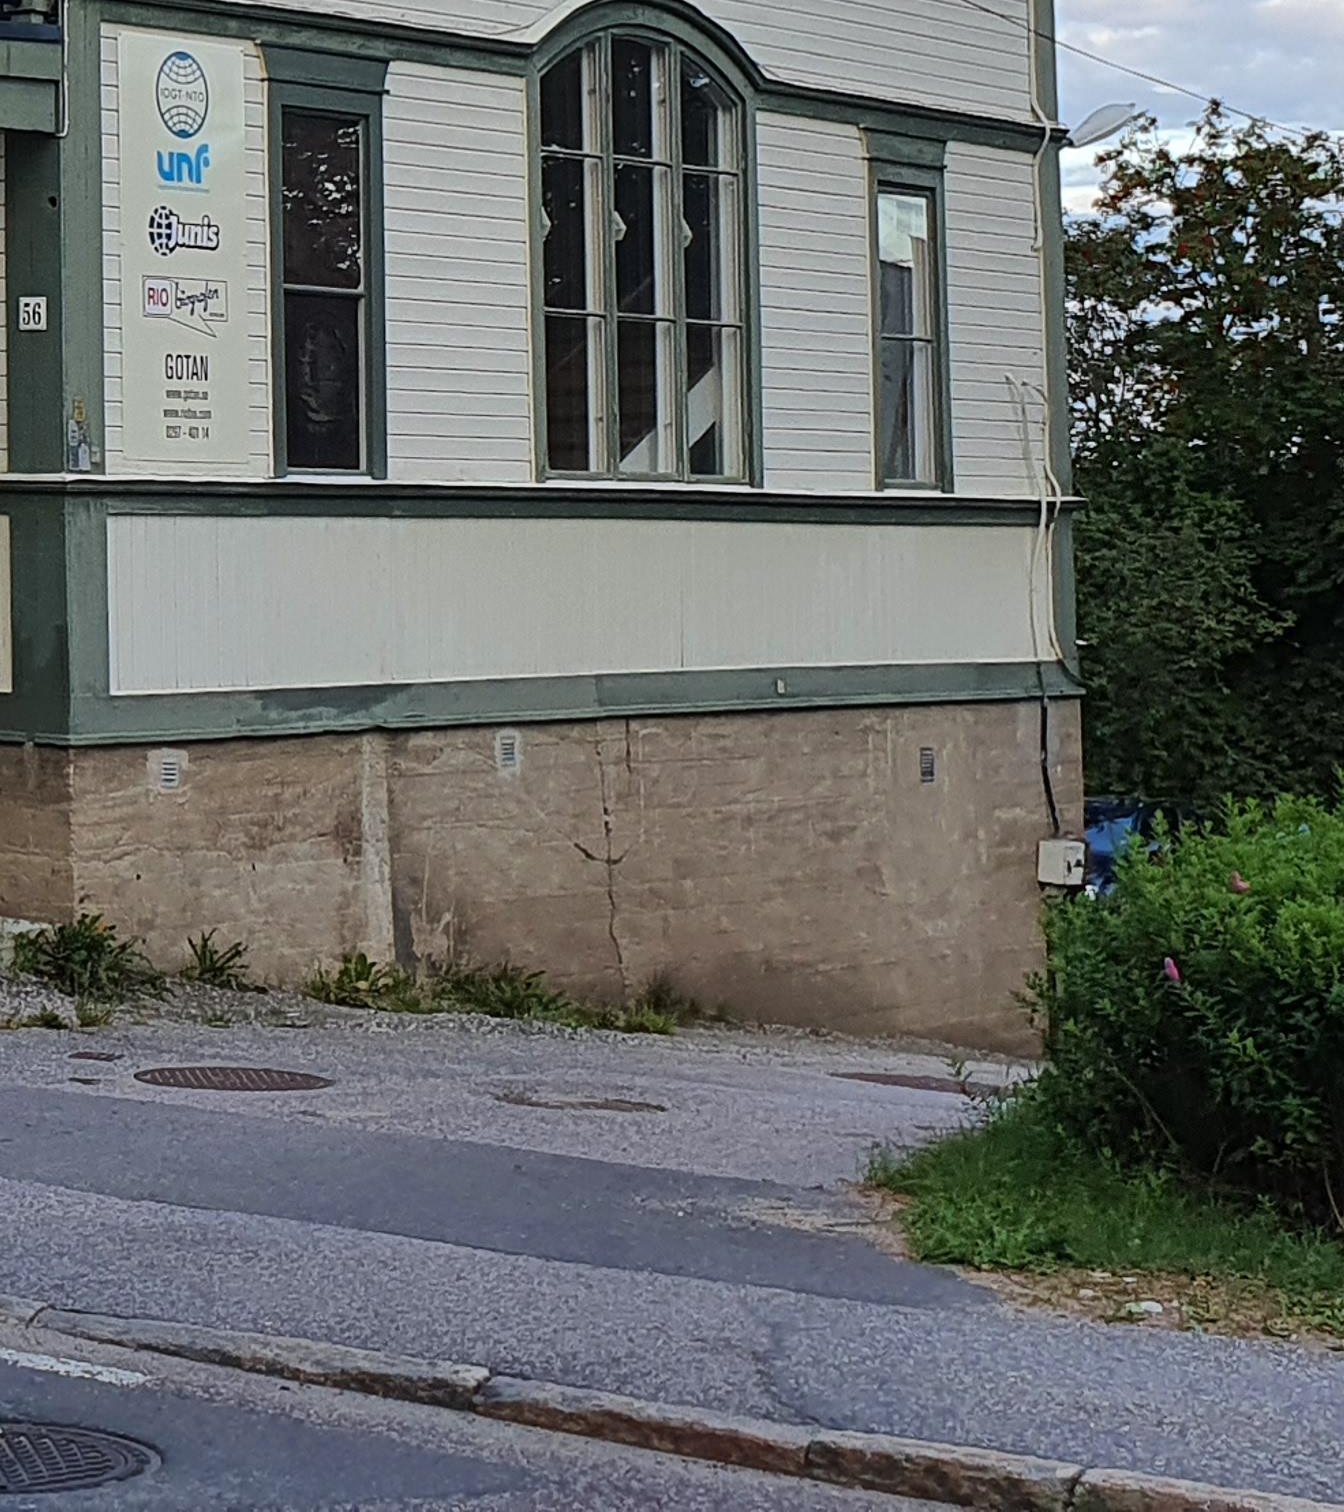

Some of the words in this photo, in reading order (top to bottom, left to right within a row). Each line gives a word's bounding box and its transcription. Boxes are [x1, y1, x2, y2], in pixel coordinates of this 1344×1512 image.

[157, 143, 210, 184] unf
[168, 214, 220, 251] Junis
[148, 287, 169, 307] RIO
[22, 302, 42, 326] 56
[165, 353, 209, 381] GOTAN
